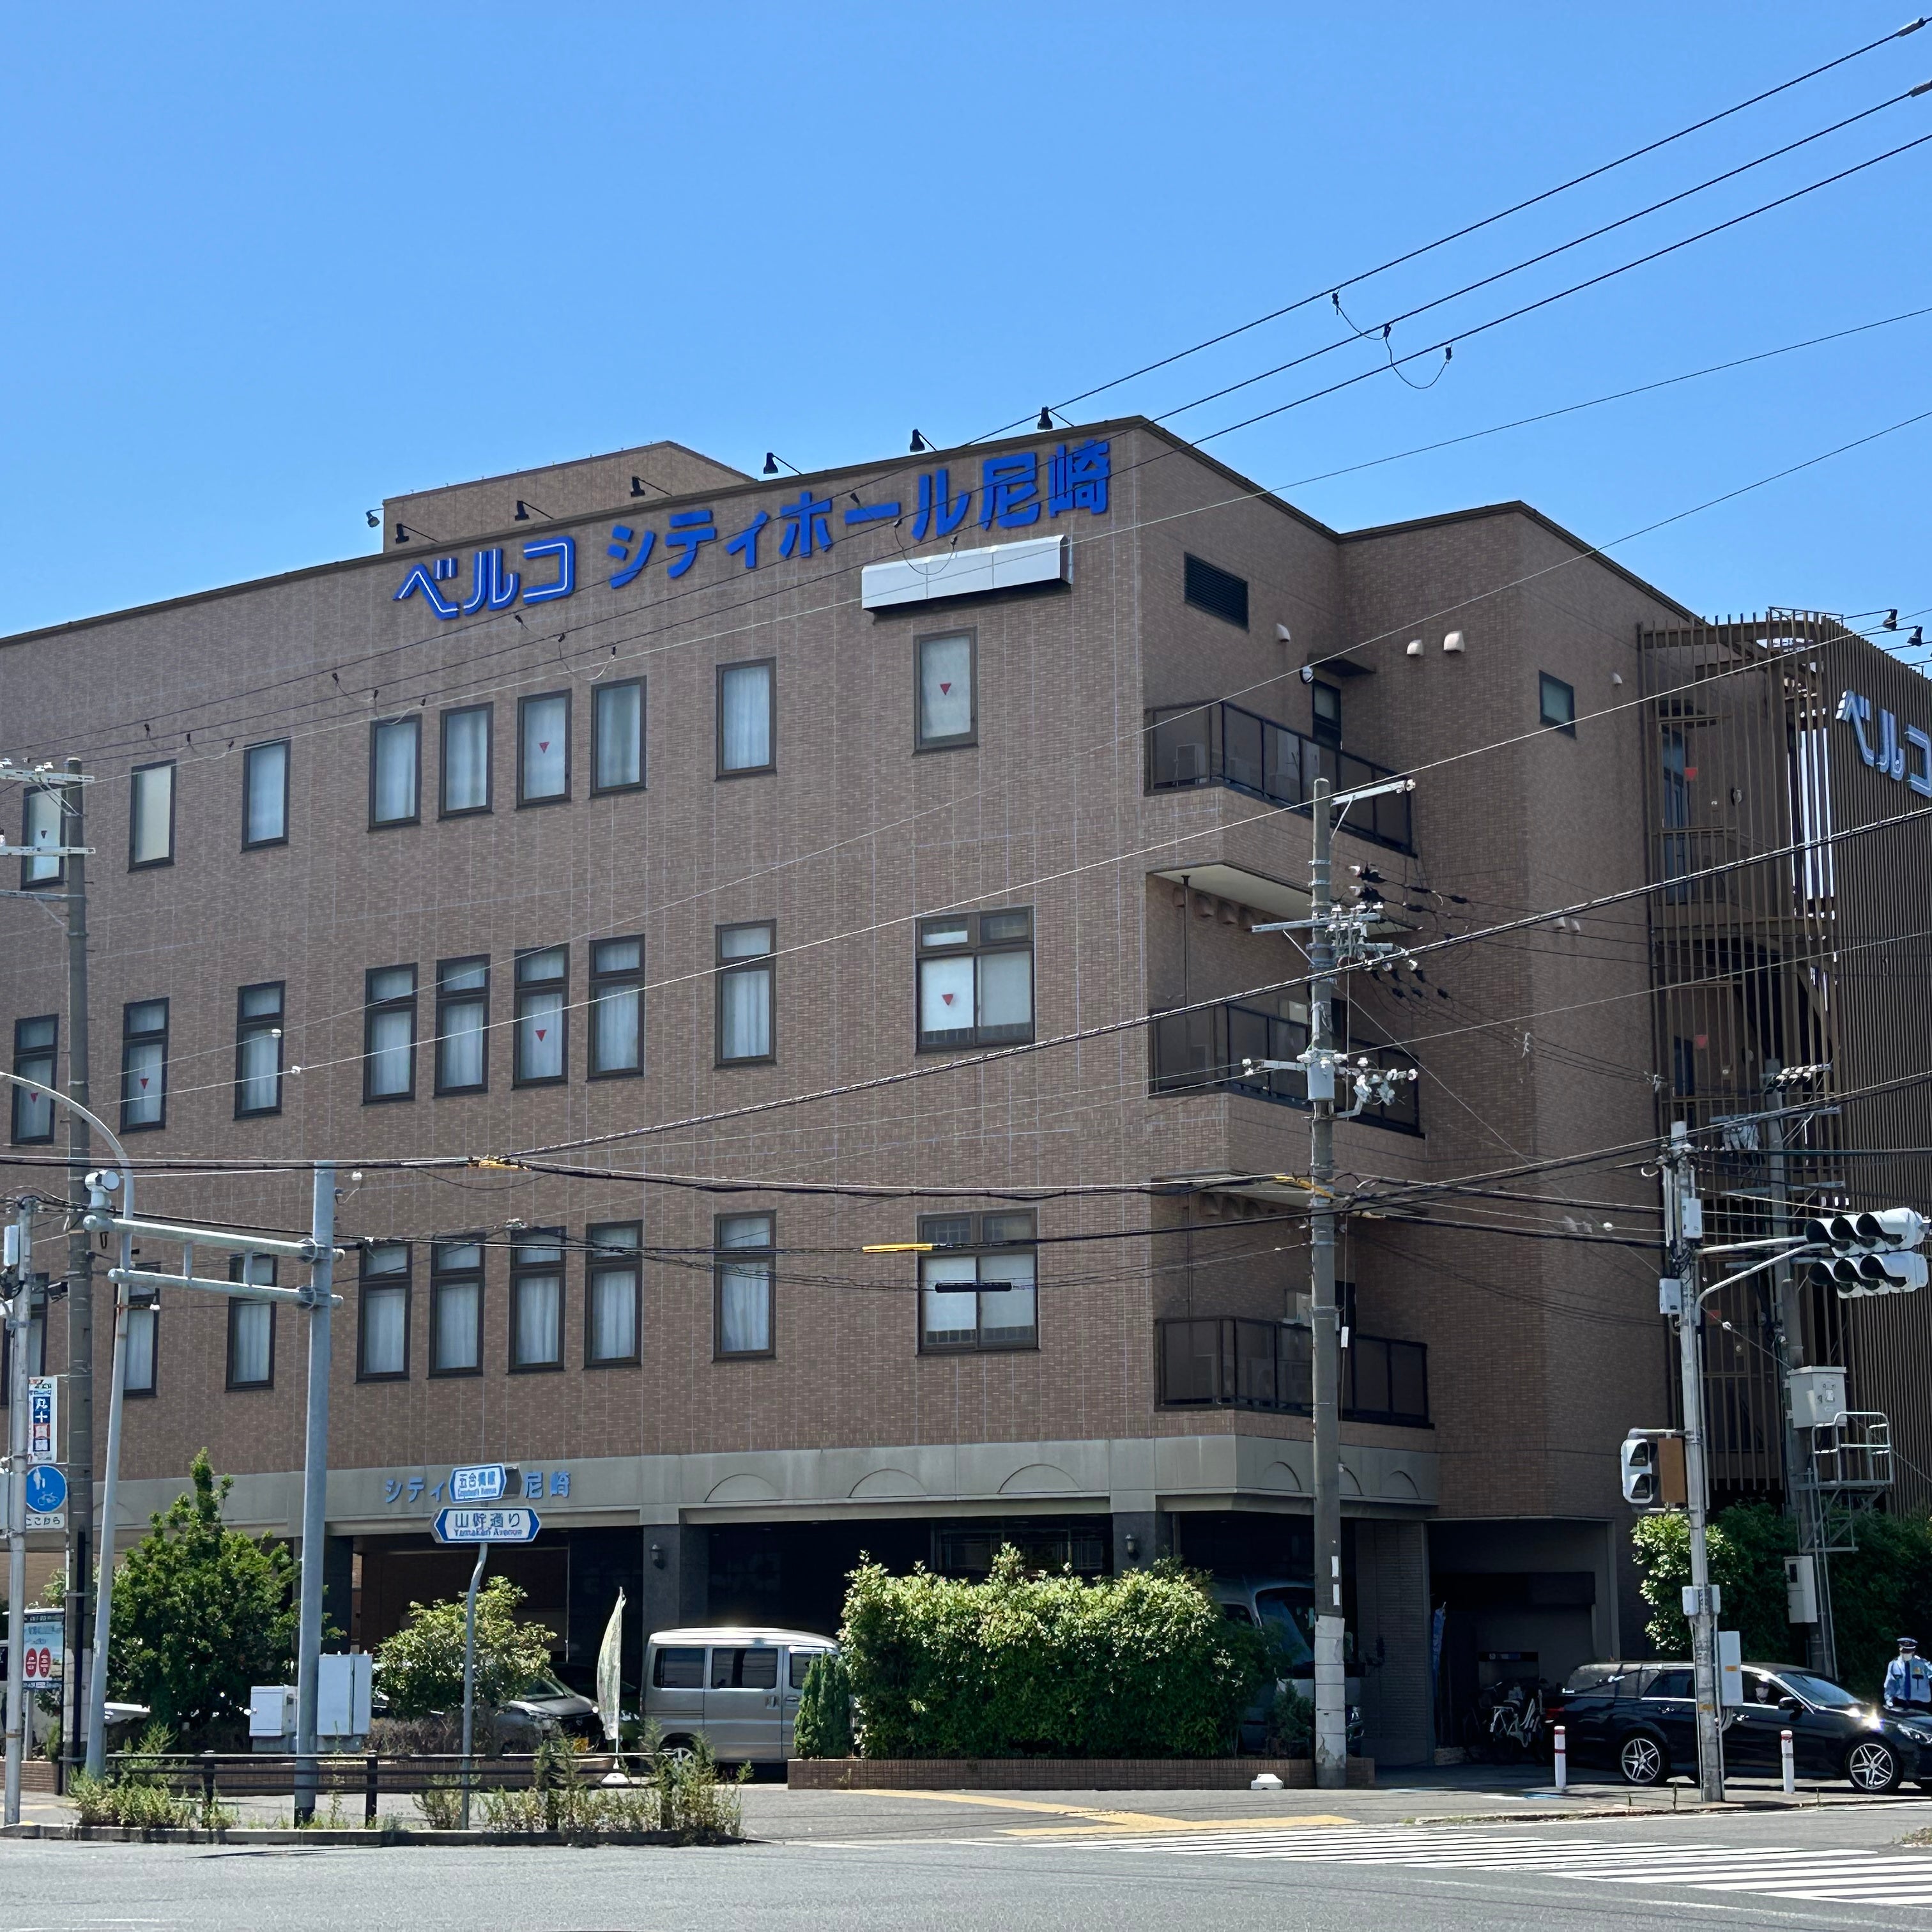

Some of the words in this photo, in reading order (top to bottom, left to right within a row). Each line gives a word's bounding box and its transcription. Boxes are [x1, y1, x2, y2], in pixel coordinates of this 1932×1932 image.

[392, 535, 576, 621] ベルコ
[606, 438, 1111, 590] シティホール尼崎
[1836, 689, 1932, 799] ベルコ
